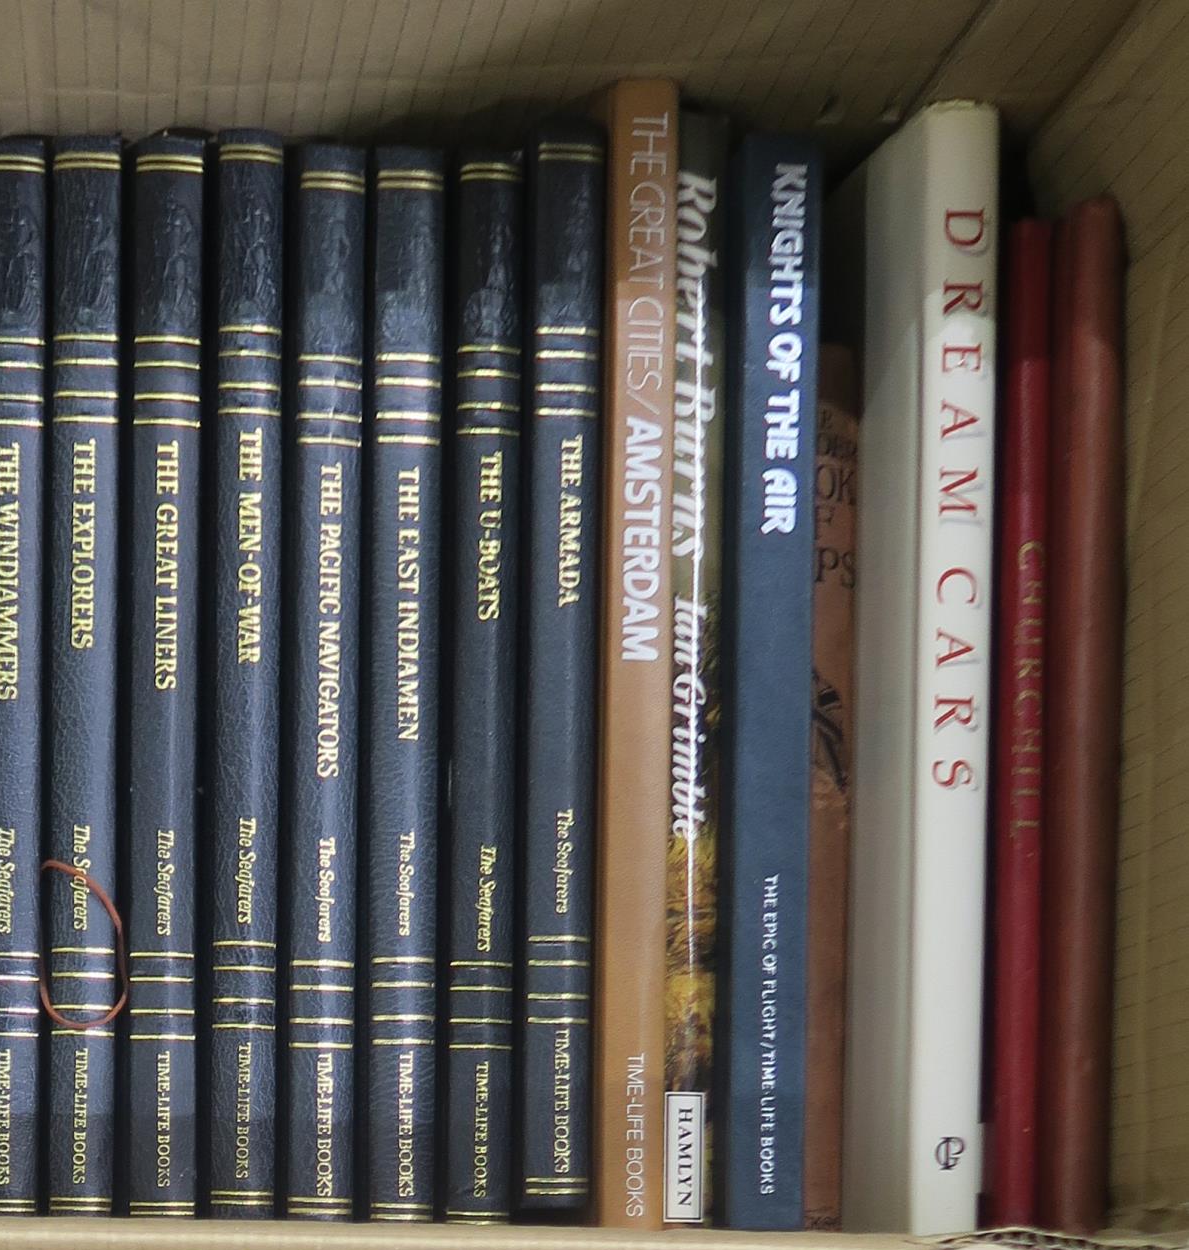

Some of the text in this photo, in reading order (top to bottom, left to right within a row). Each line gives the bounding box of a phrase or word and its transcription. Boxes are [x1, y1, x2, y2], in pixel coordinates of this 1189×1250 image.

[630, 111, 669, 176] THE
[628, 180, 666, 291] GREAT
[760, 163, 808, 535] KNIGHTS OF THE AIR
[71, 438, 96, 650] THE EXPLORERS
[155, 440, 178, 691] THE GREAT LINERS
[238, 427, 262, 664] THE MEN-OF-WAR
[477, 451, 503, 622] THE U-BOATS
[559, 434, 583, 608] THE ARMADA
[931, 207, 985, 789] DREAM CARS
[317, 462, 342, 779] THE PACIFIC NAVIGATORS
[397, 465, 420, 741] THE EAST INDIAMEN
[1009, 541, 1046, 838] CHURCHILL
[155, 829, 175, 936] The Seafarers
[761, 912, 778, 951] EPIC
[761, 954, 778, 976] OF
[764, 874, 778, 907] THE
[626, 1052, 645, 1217] TIME-LIFE BOOKS
[678, 1108, 694, 1206] HAMLYN
[760, 1137, 776, 1195] BOOKS
